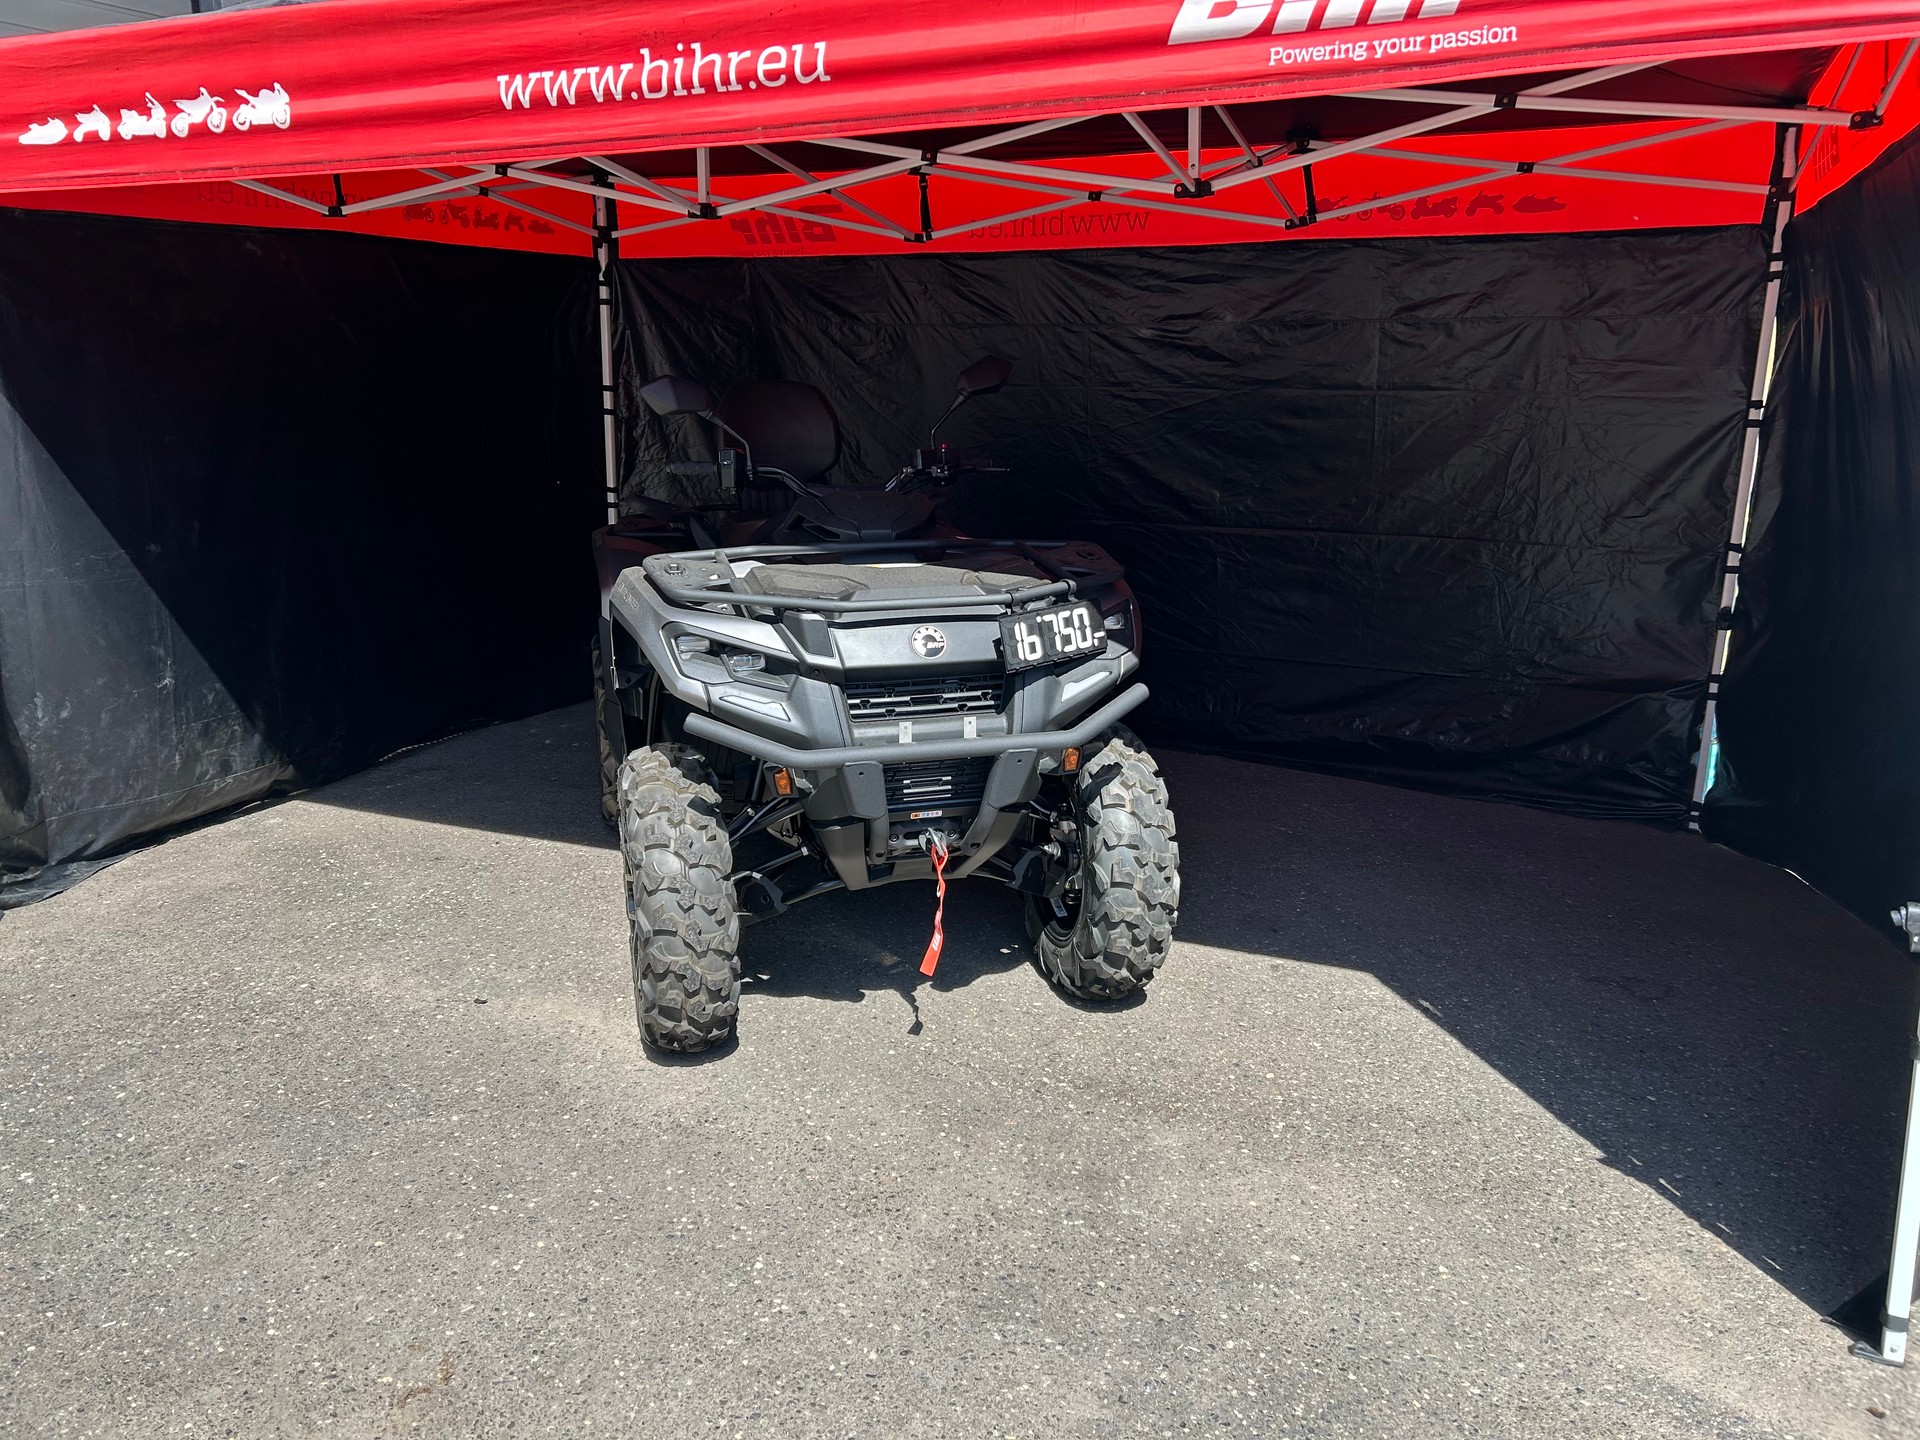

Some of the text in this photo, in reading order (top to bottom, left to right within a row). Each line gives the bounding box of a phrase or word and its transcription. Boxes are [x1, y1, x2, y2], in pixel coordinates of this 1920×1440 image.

[1268, 24, 1517, 66] Powering your passion
[497, 42, 831, 110] www.bihr.eu
